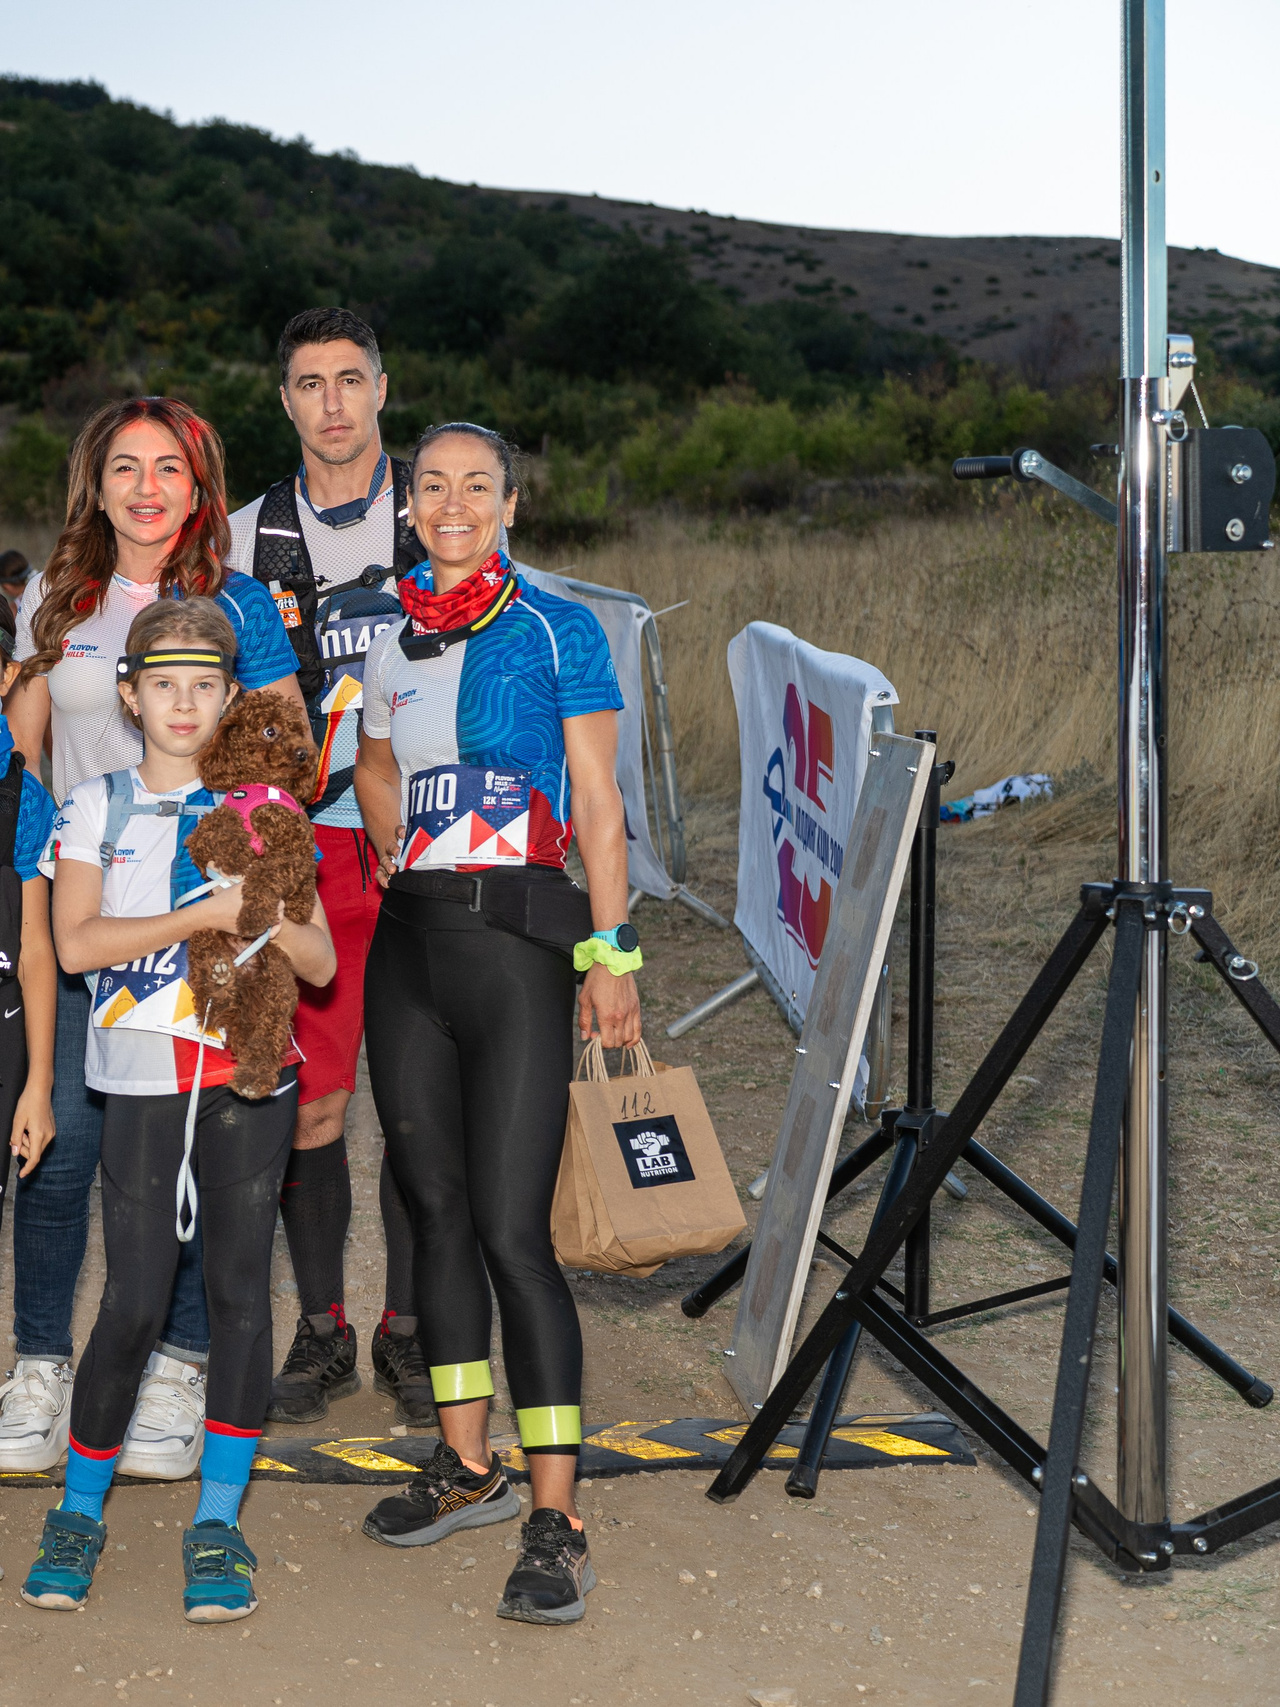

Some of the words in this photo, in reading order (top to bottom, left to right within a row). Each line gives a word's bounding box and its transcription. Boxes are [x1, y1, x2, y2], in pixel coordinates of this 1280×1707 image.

[69, 644, 99, 652] PLOVDIV
[621, 1091, 656, 1120] 112
[641, 1155, 671, 1169] LAB
[640, 1166, 679, 1179] NUTRITION
